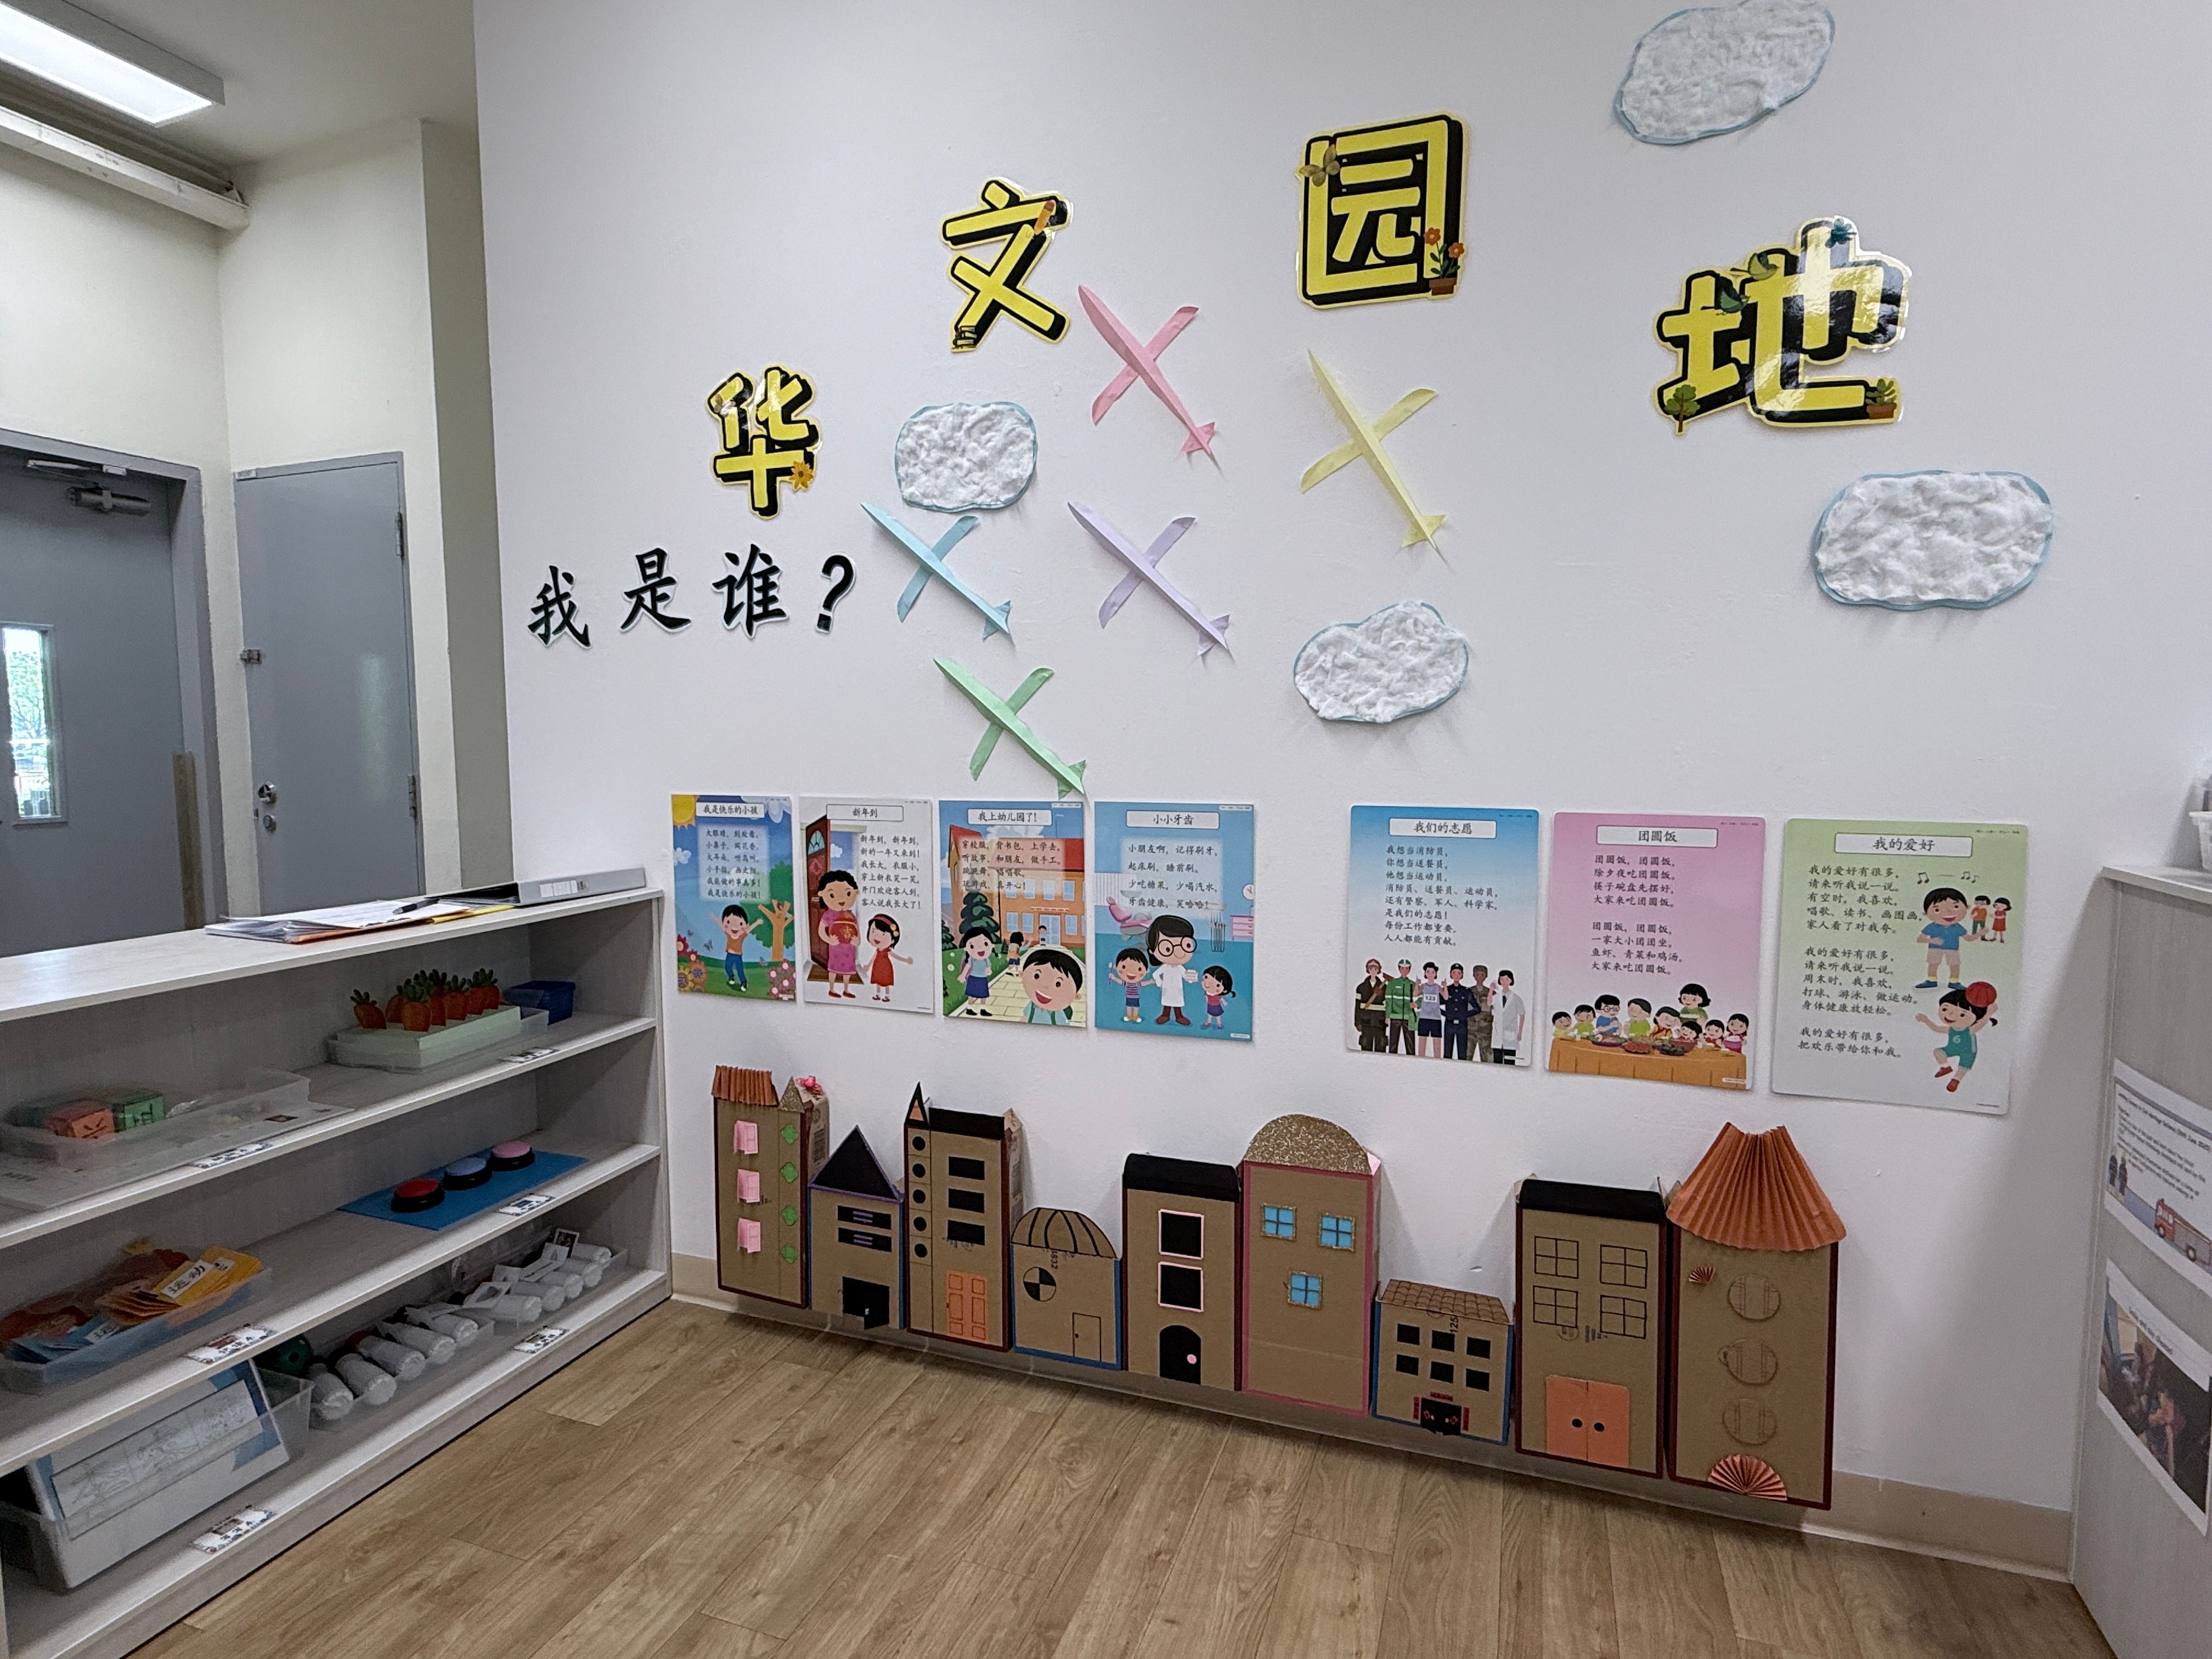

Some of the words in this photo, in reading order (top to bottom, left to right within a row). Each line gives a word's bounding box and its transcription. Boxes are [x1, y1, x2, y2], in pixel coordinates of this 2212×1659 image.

[708, 366, 821, 518] 华
[941, 178, 1071, 350] 文
[1300, 113, 1466, 306] 园
[1654, 217, 1908, 431] 地
[703, 804, 758, 815] 我是快乐的小孩
[852, 808, 877, 818] 新年到
[978, 811, 1037, 822] 我上幼儿园了！
[1153, 814, 1194, 825] 小小牙齿
[1413, 821, 1472, 834] 我们的志愿
[1638, 830, 1678, 843] 团圆饭
[1872, 837, 1936, 851] 我的爱好
[861, 848, 920, 857] 新的一年又来到！
[862, 898, 921, 909] 客人说我长大了！
[1385, 909, 1448, 920] 是我们的志愿！
